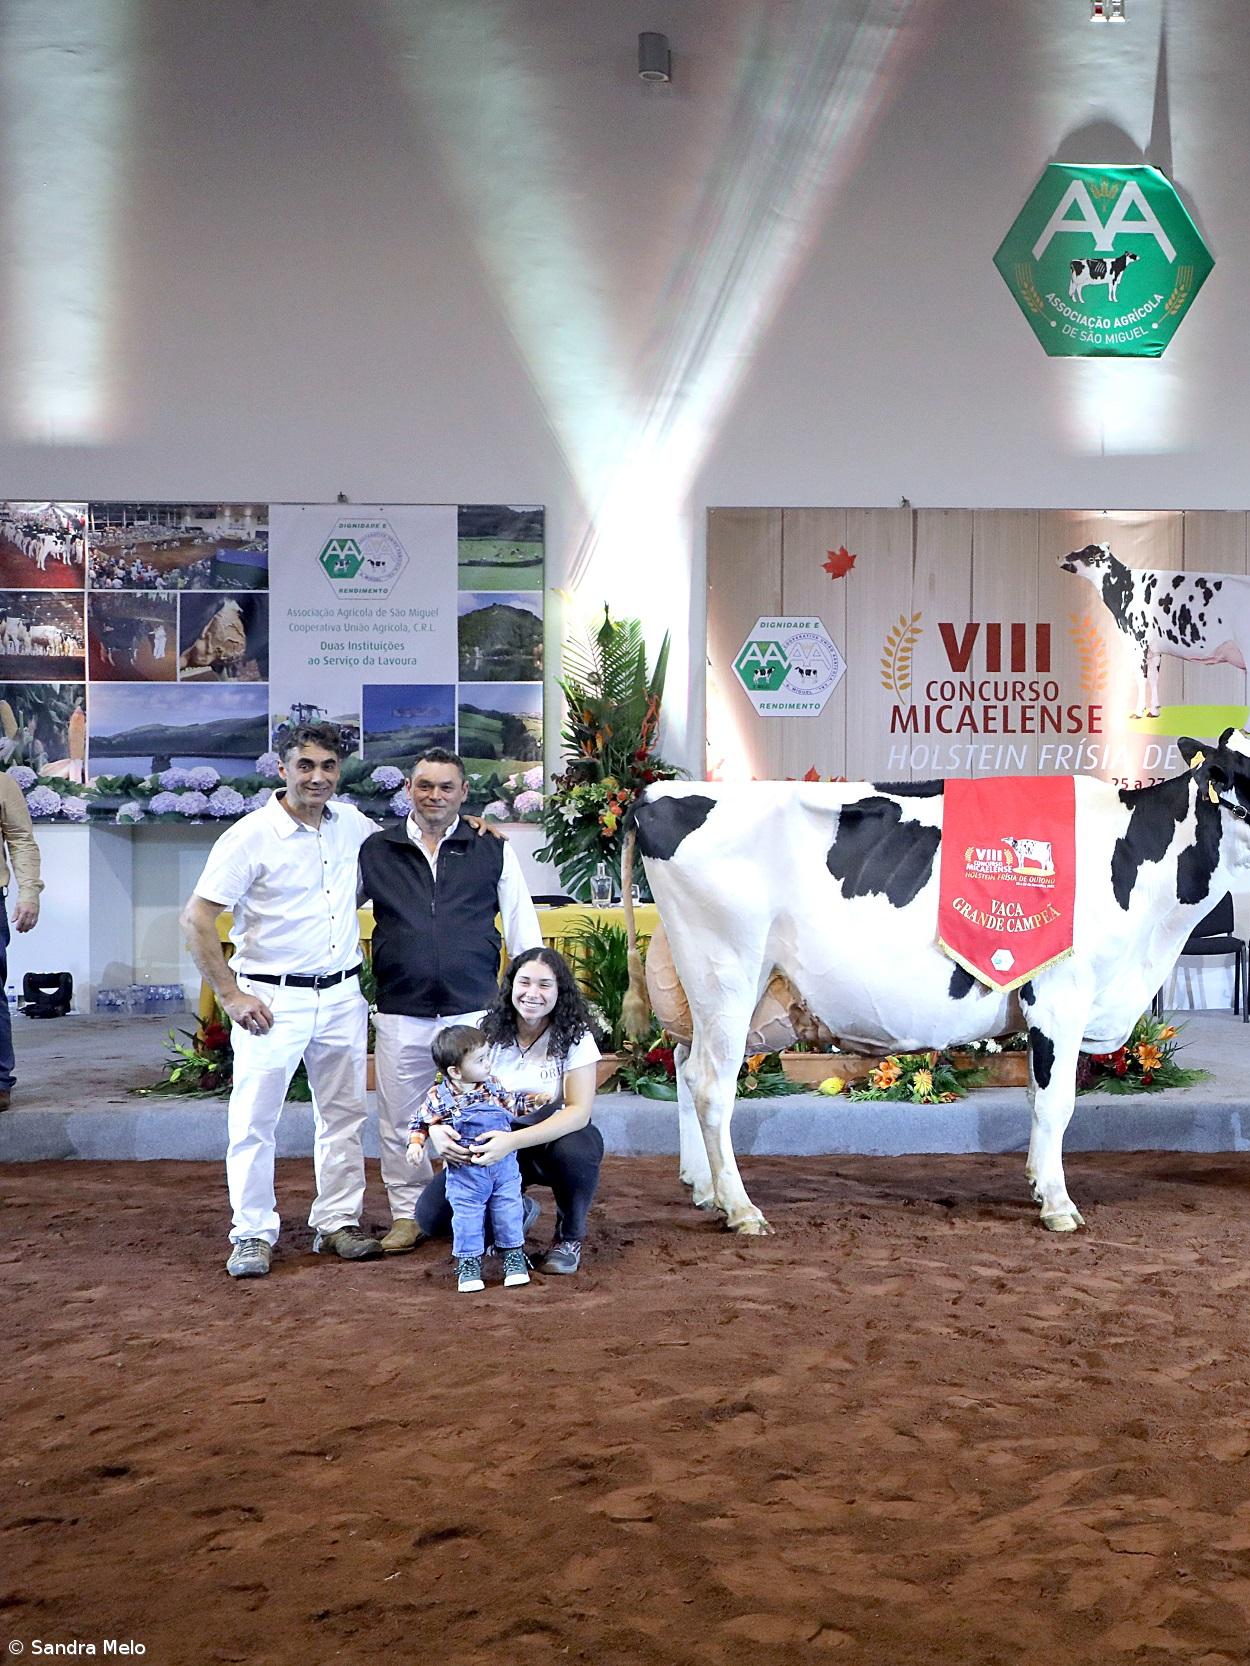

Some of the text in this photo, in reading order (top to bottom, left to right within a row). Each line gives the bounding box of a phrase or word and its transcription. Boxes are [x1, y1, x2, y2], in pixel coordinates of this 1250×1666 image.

[1045, 292, 1164, 330] ASSOCIAÇÃO AGRÍCOLA
[1062, 325, 1149, 344] DE SÃO MIGUEL
[287, 607, 439, 619] Associação Agrícola de São Miguel
[289, 622, 436, 634] Cooperativa União Agrícola, C.R.L.
[760, 621, 820, 629] DIGNIDADE E
[320, 641, 405, 653] Duas Instituições
[938, 623, 1051, 672] VIII
[307, 655, 417, 667] ao Serviço da Lavoura
[926, 680, 1059, 702] CONCURSO
[890, 706, 1103, 734] MICAELENSE
[887, 737, 1180, 770] HOLSTEIN FRÍSIA DE
[1134, 780, 1143, 789] a
[975, 848, 1003, 861] VIII
[965, 863, 1013, 873] MICAELENSE
[965, 872, 1056, 884] HOLSTEIN FRÍSIA DE OUTONO
[952, 897, 1061, 932] GRANDE CAMPEÃ
[991, 899, 1024, 917] VACA
